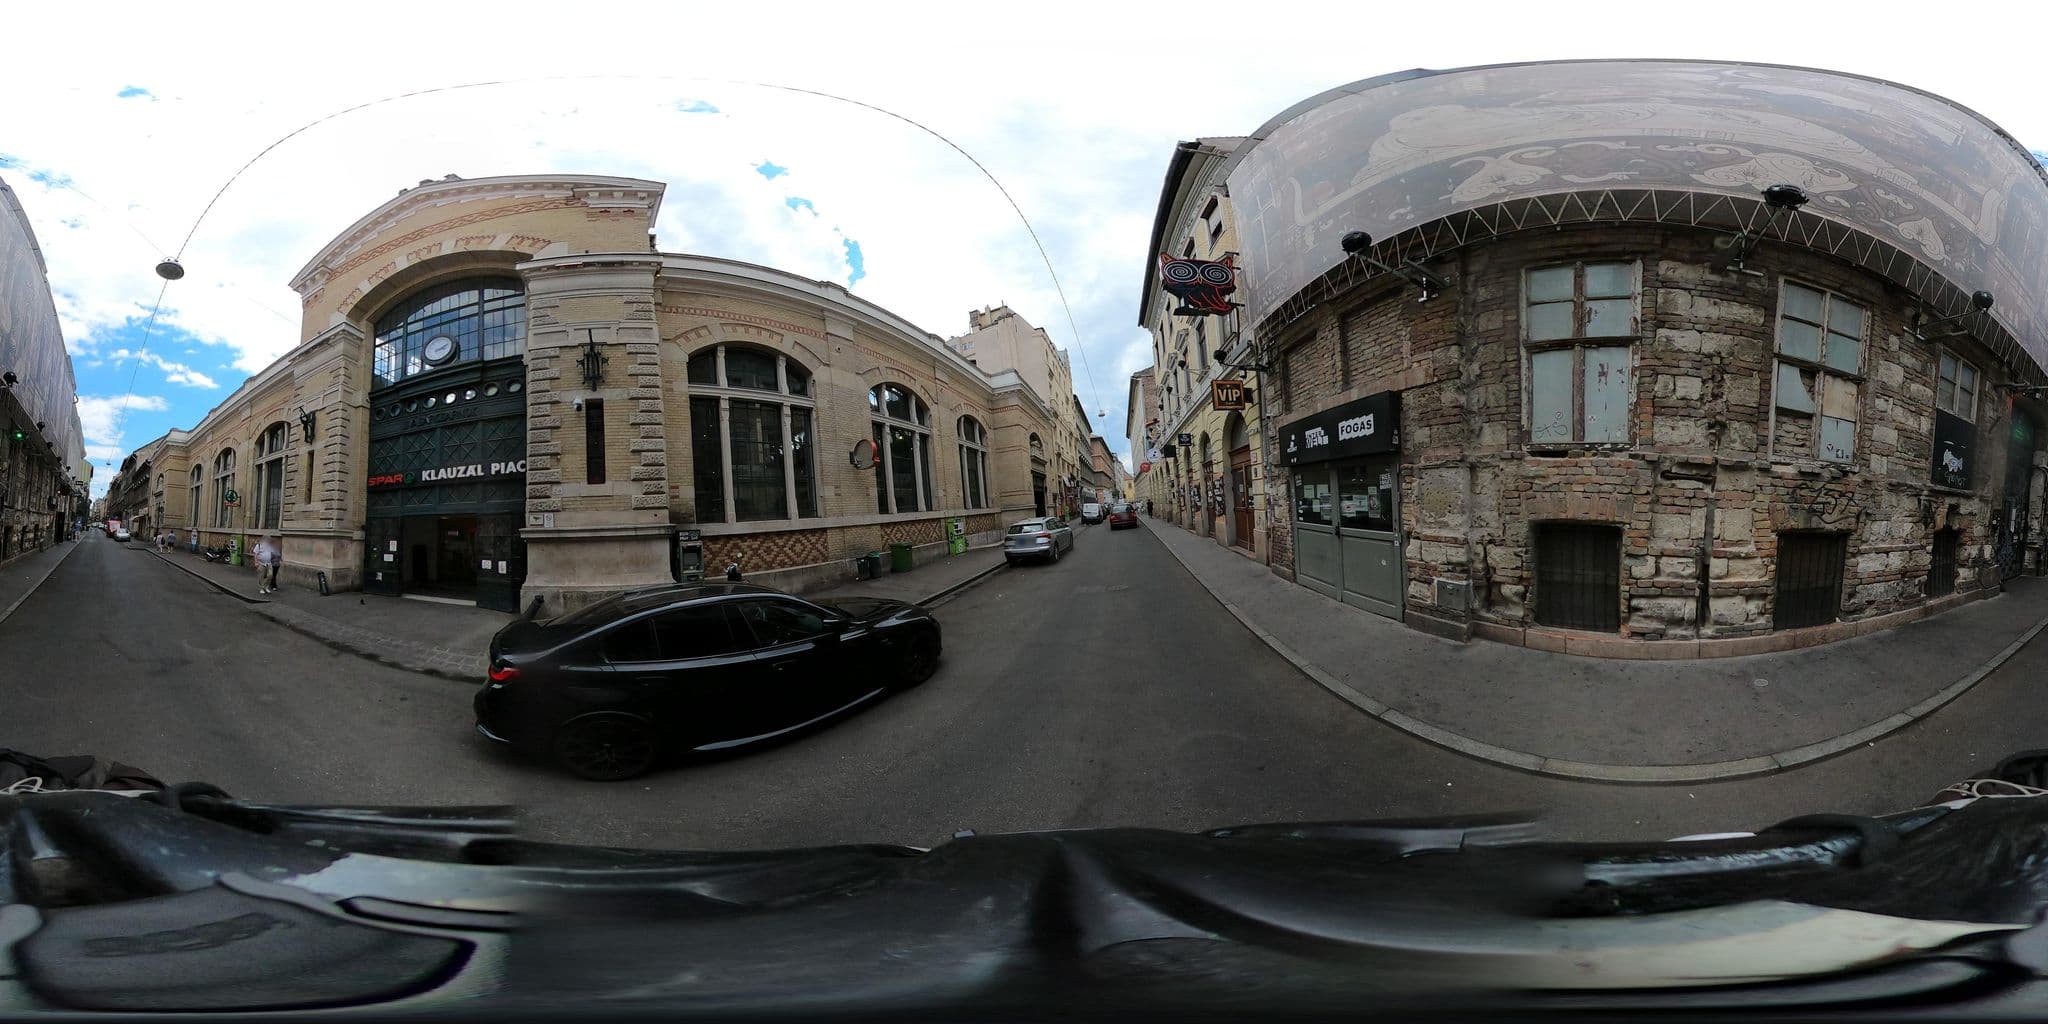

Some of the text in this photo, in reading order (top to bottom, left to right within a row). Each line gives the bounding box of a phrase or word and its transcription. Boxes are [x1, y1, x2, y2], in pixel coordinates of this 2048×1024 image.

[1217, 388, 1241, 402] VIP
[1340, 418, 1373, 436] FOGAS
[422, 460, 526, 482] KLAUZÁL PIAC
[368, 473, 404, 487] SPAR
